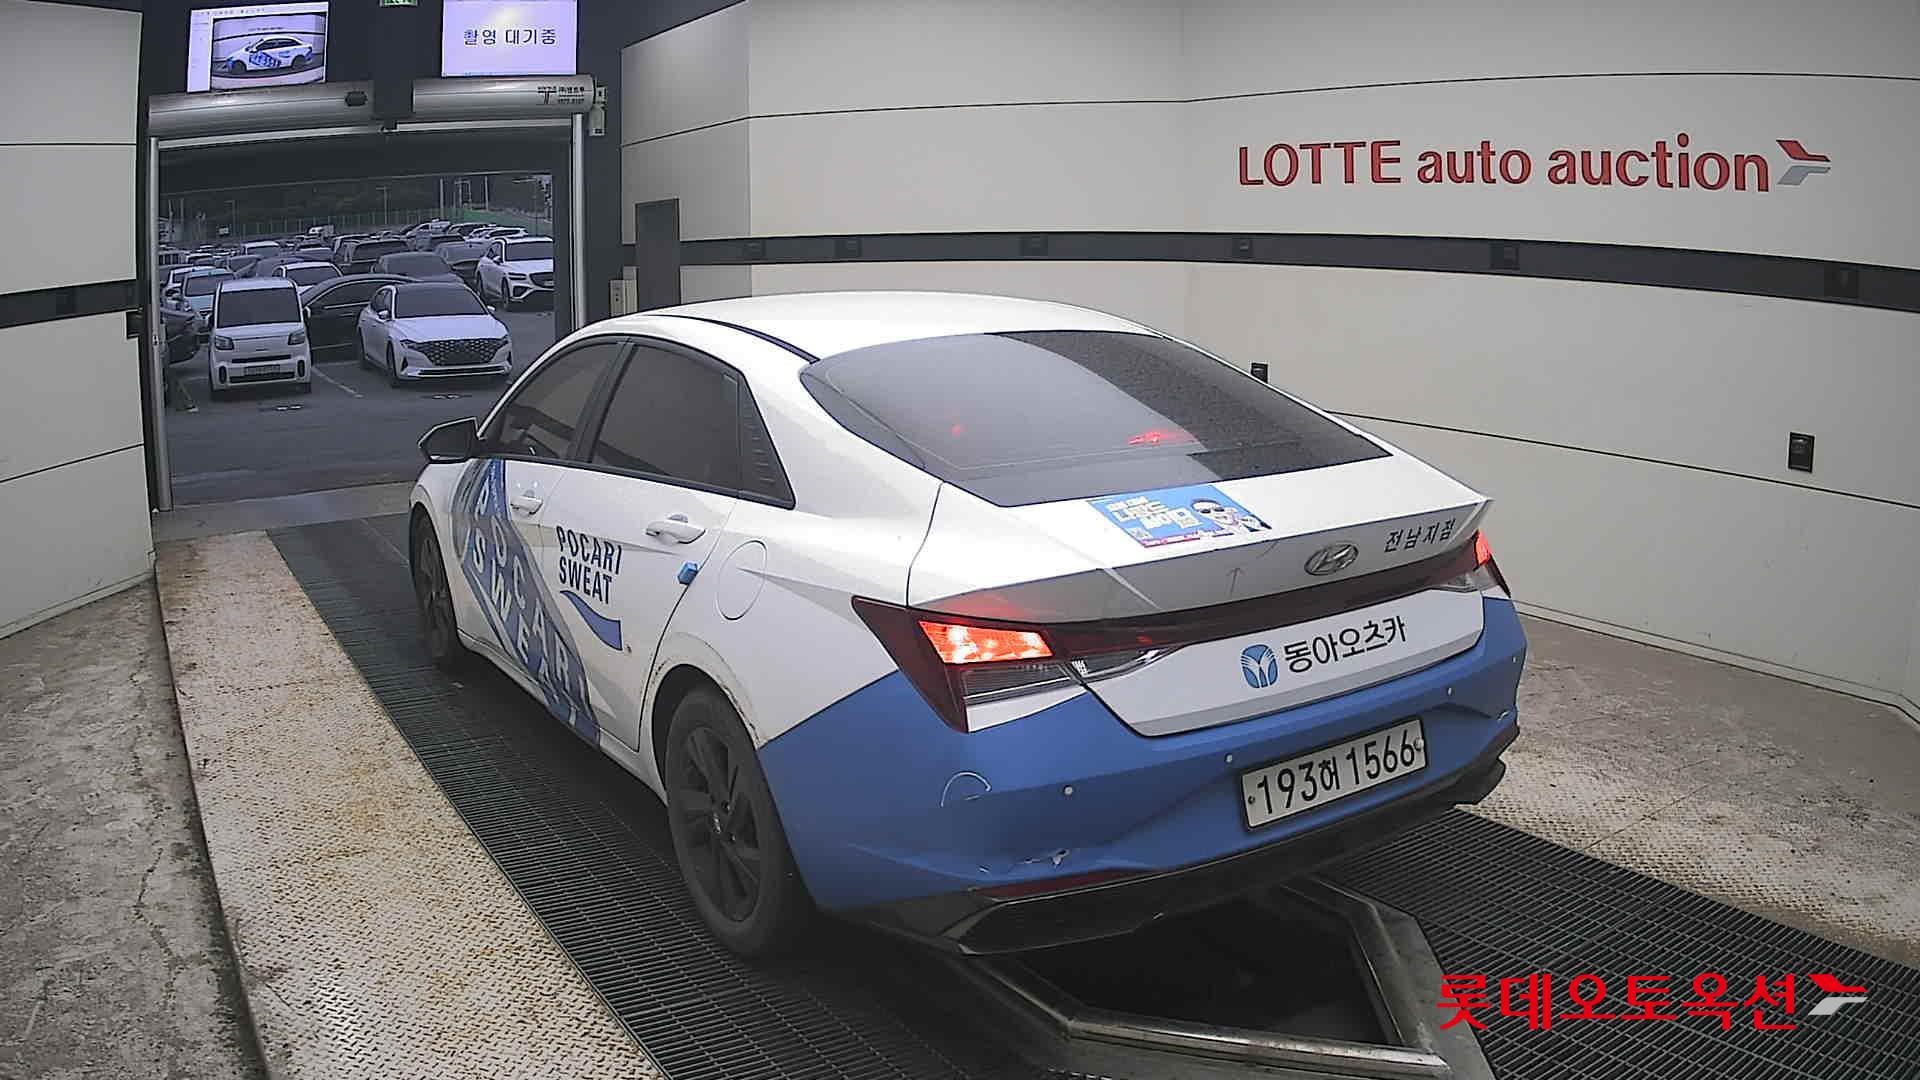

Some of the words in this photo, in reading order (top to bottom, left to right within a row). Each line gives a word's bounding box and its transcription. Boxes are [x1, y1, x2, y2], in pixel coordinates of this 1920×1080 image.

[505, 29, 556, 45] 대기중
[1238, 140, 1401, 187] LOTTE
[1417, 140, 1532, 186] auto
[1547, 132, 1770, 193] auction
[556, 525, 622, 576] POCARI
[1384, 518, 1456, 553] 전남지점
[559, 556, 613, 605] SWEAT
[1283, 615, 1406, 673] 동아오츠카
[1346, 729, 1415, 785] 1566
